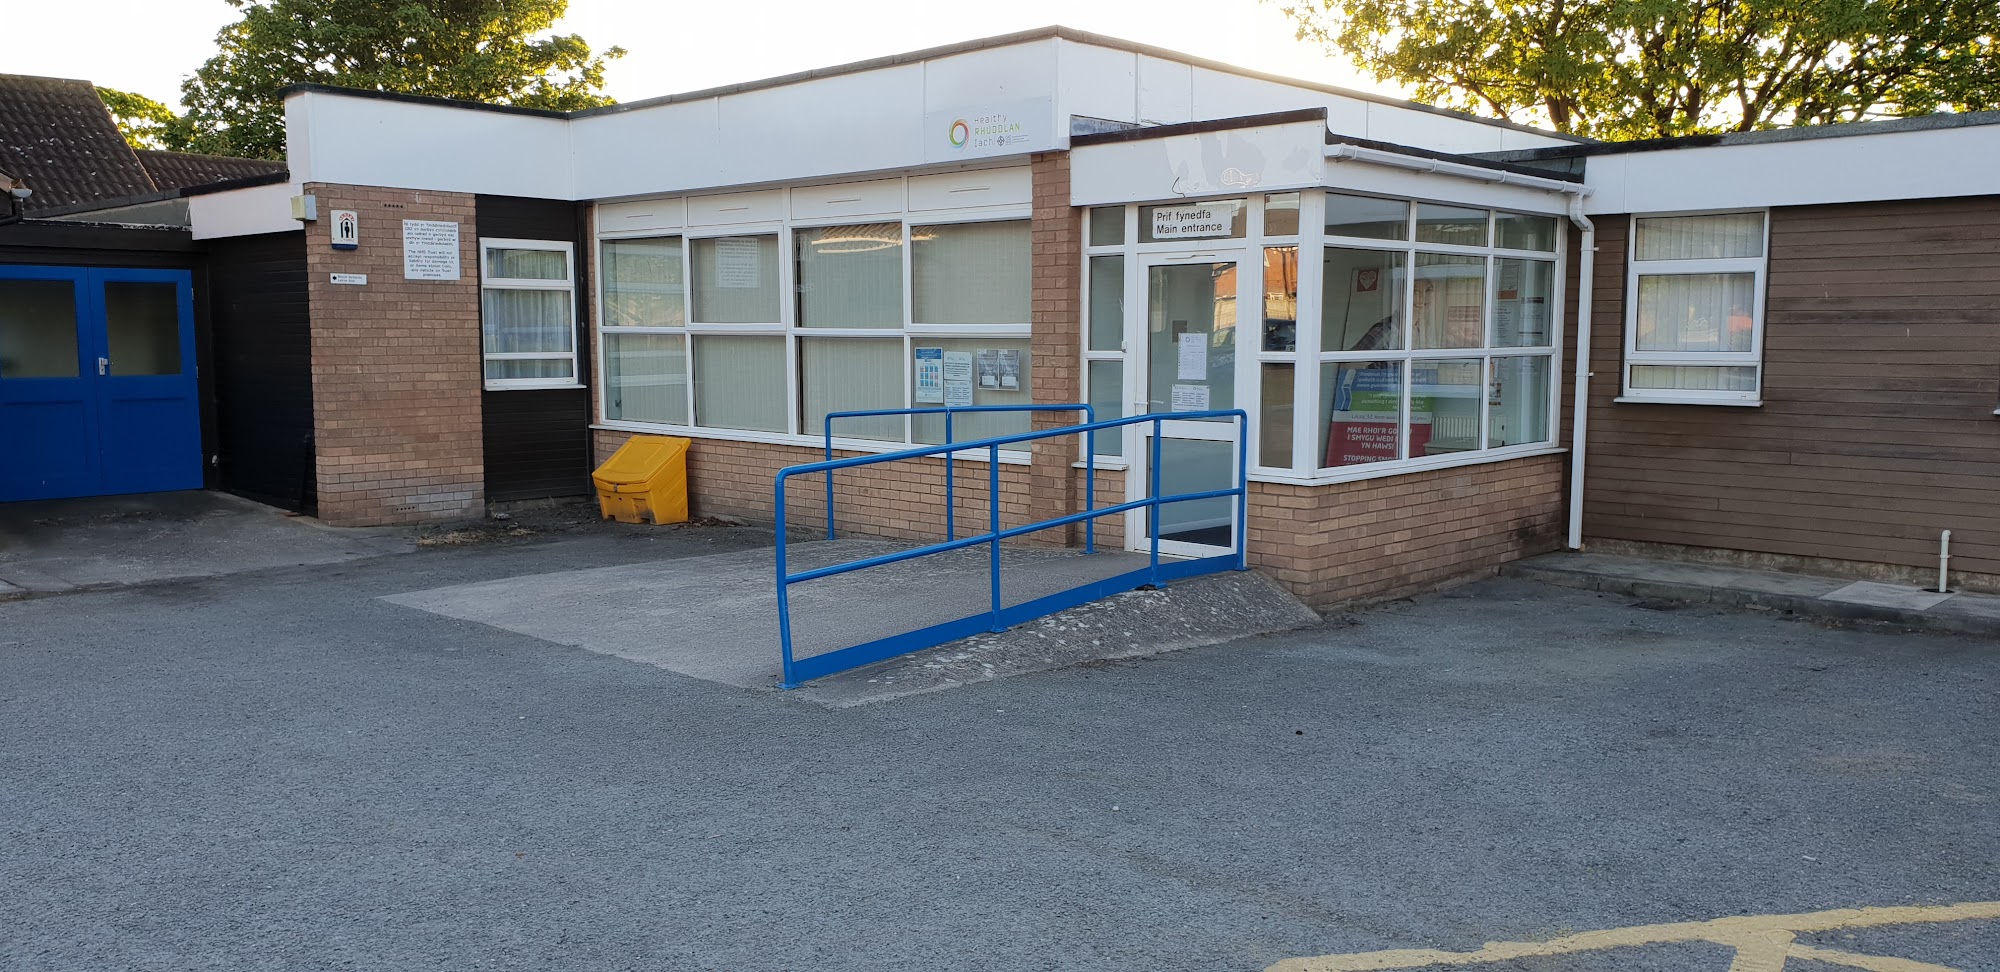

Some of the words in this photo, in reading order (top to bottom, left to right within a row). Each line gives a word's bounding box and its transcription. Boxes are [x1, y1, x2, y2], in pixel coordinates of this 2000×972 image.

[974, 114, 1007, 124] Healthy
[974, 123, 1020, 136] RHUDDLAN
[1156, 212, 1172, 221] Prif
[1176, 210, 1211, 222] fynedfa
[1156, 224, 1177, 234] Main
[1182, 223, 1222, 232] entrance
